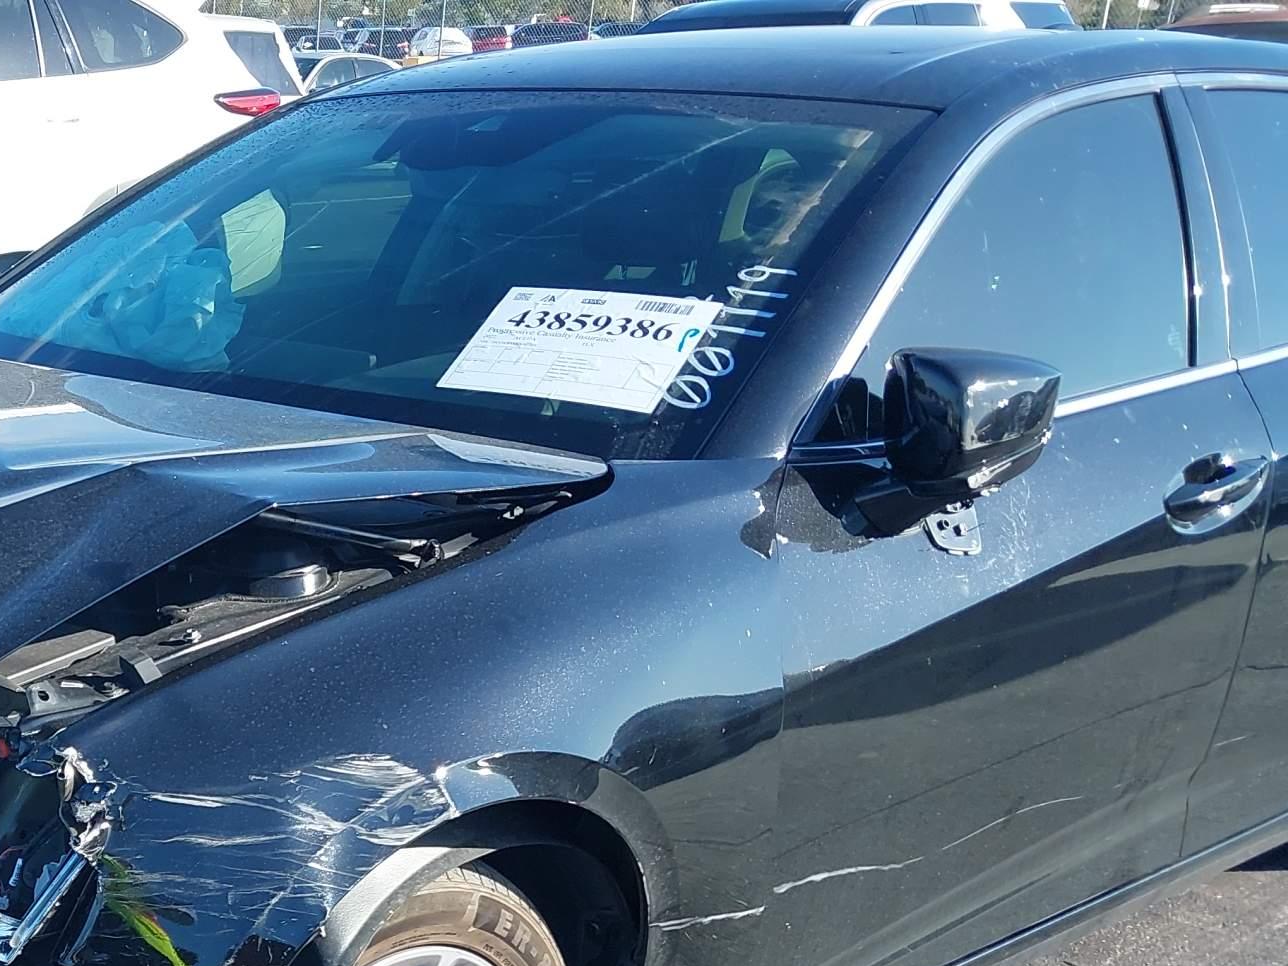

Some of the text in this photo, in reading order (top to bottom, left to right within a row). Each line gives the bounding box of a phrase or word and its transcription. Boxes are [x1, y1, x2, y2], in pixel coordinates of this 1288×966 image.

[487, 327, 536, 336] Progressive
[536, 330, 573, 339] Casualty
[575, 333, 617, 343] Insurance
[506, 309, 680, 342] 43859386
